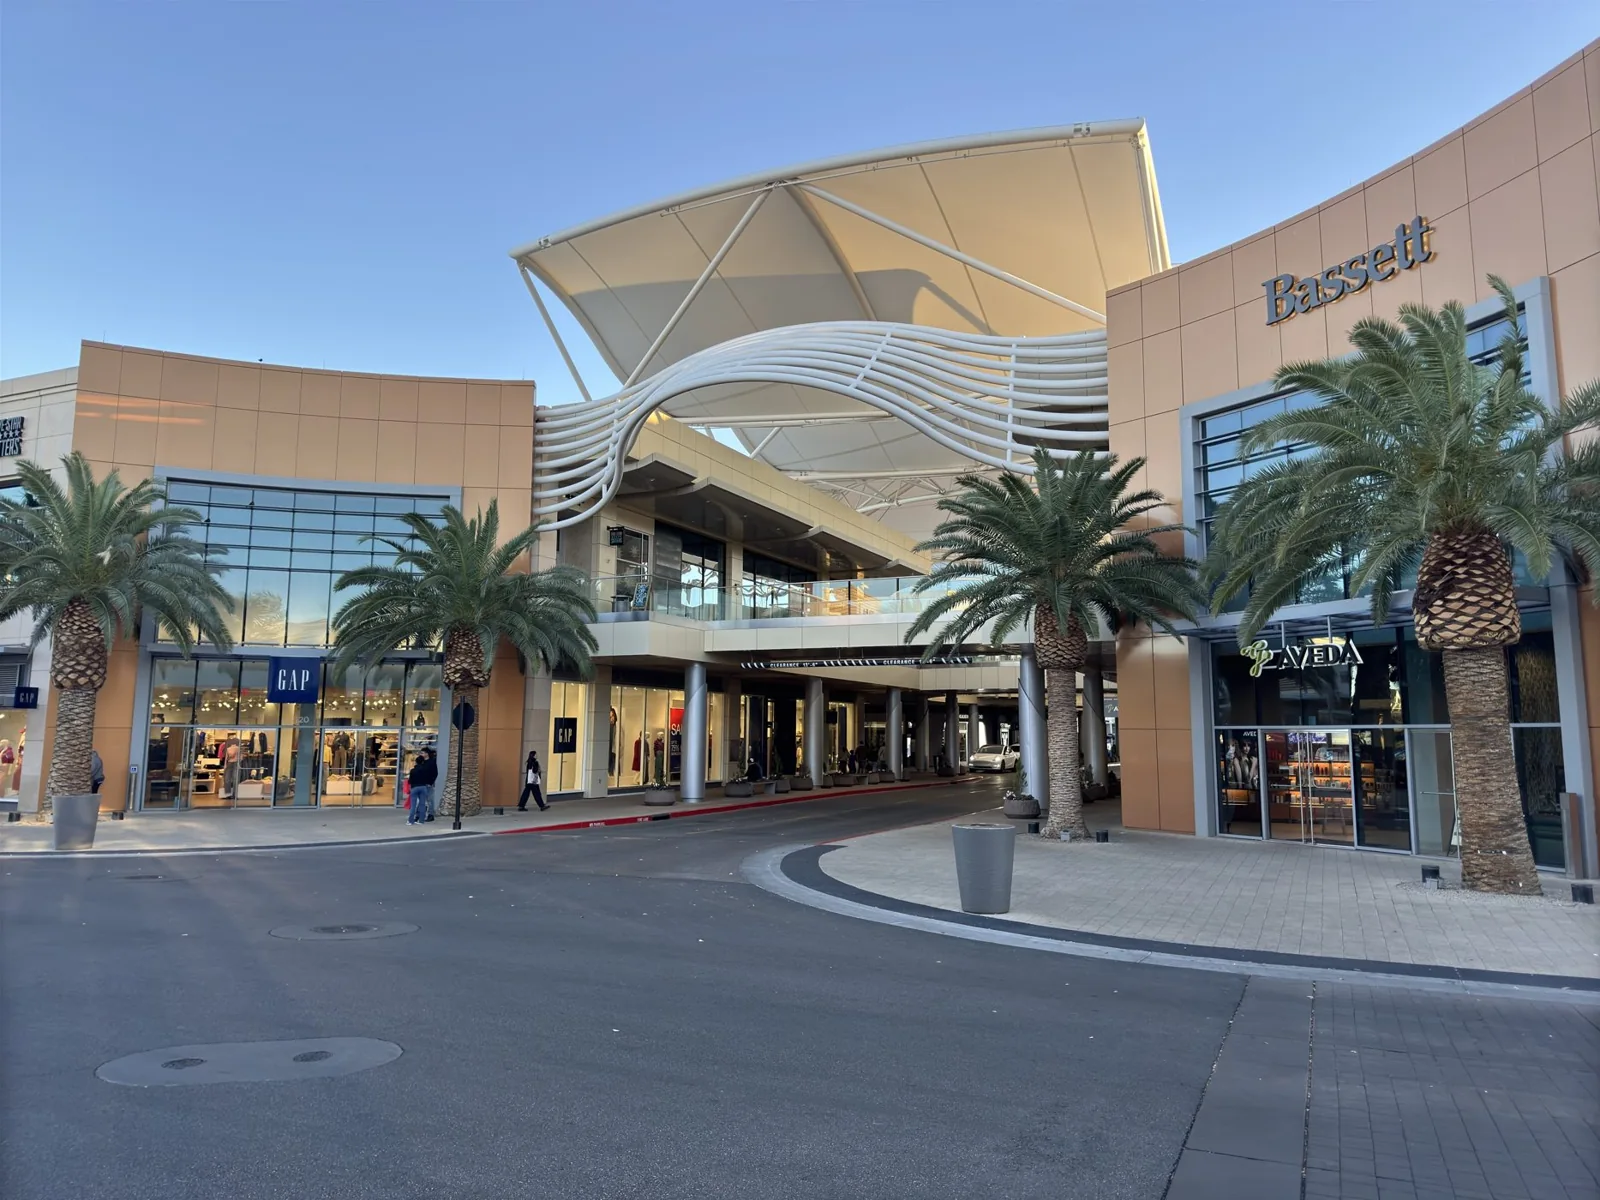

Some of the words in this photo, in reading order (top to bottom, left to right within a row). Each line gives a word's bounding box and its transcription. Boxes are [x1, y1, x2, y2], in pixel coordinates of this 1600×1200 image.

[1261, 215, 1436, 326] Bassett
[1277, 638, 1364, 670] AVEDA
[278, 668, 310, 691] GAP
[19, 691, 35, 704] GAP
[558, 727, 573, 743] GAP
[671, 723, 683, 736] SA
